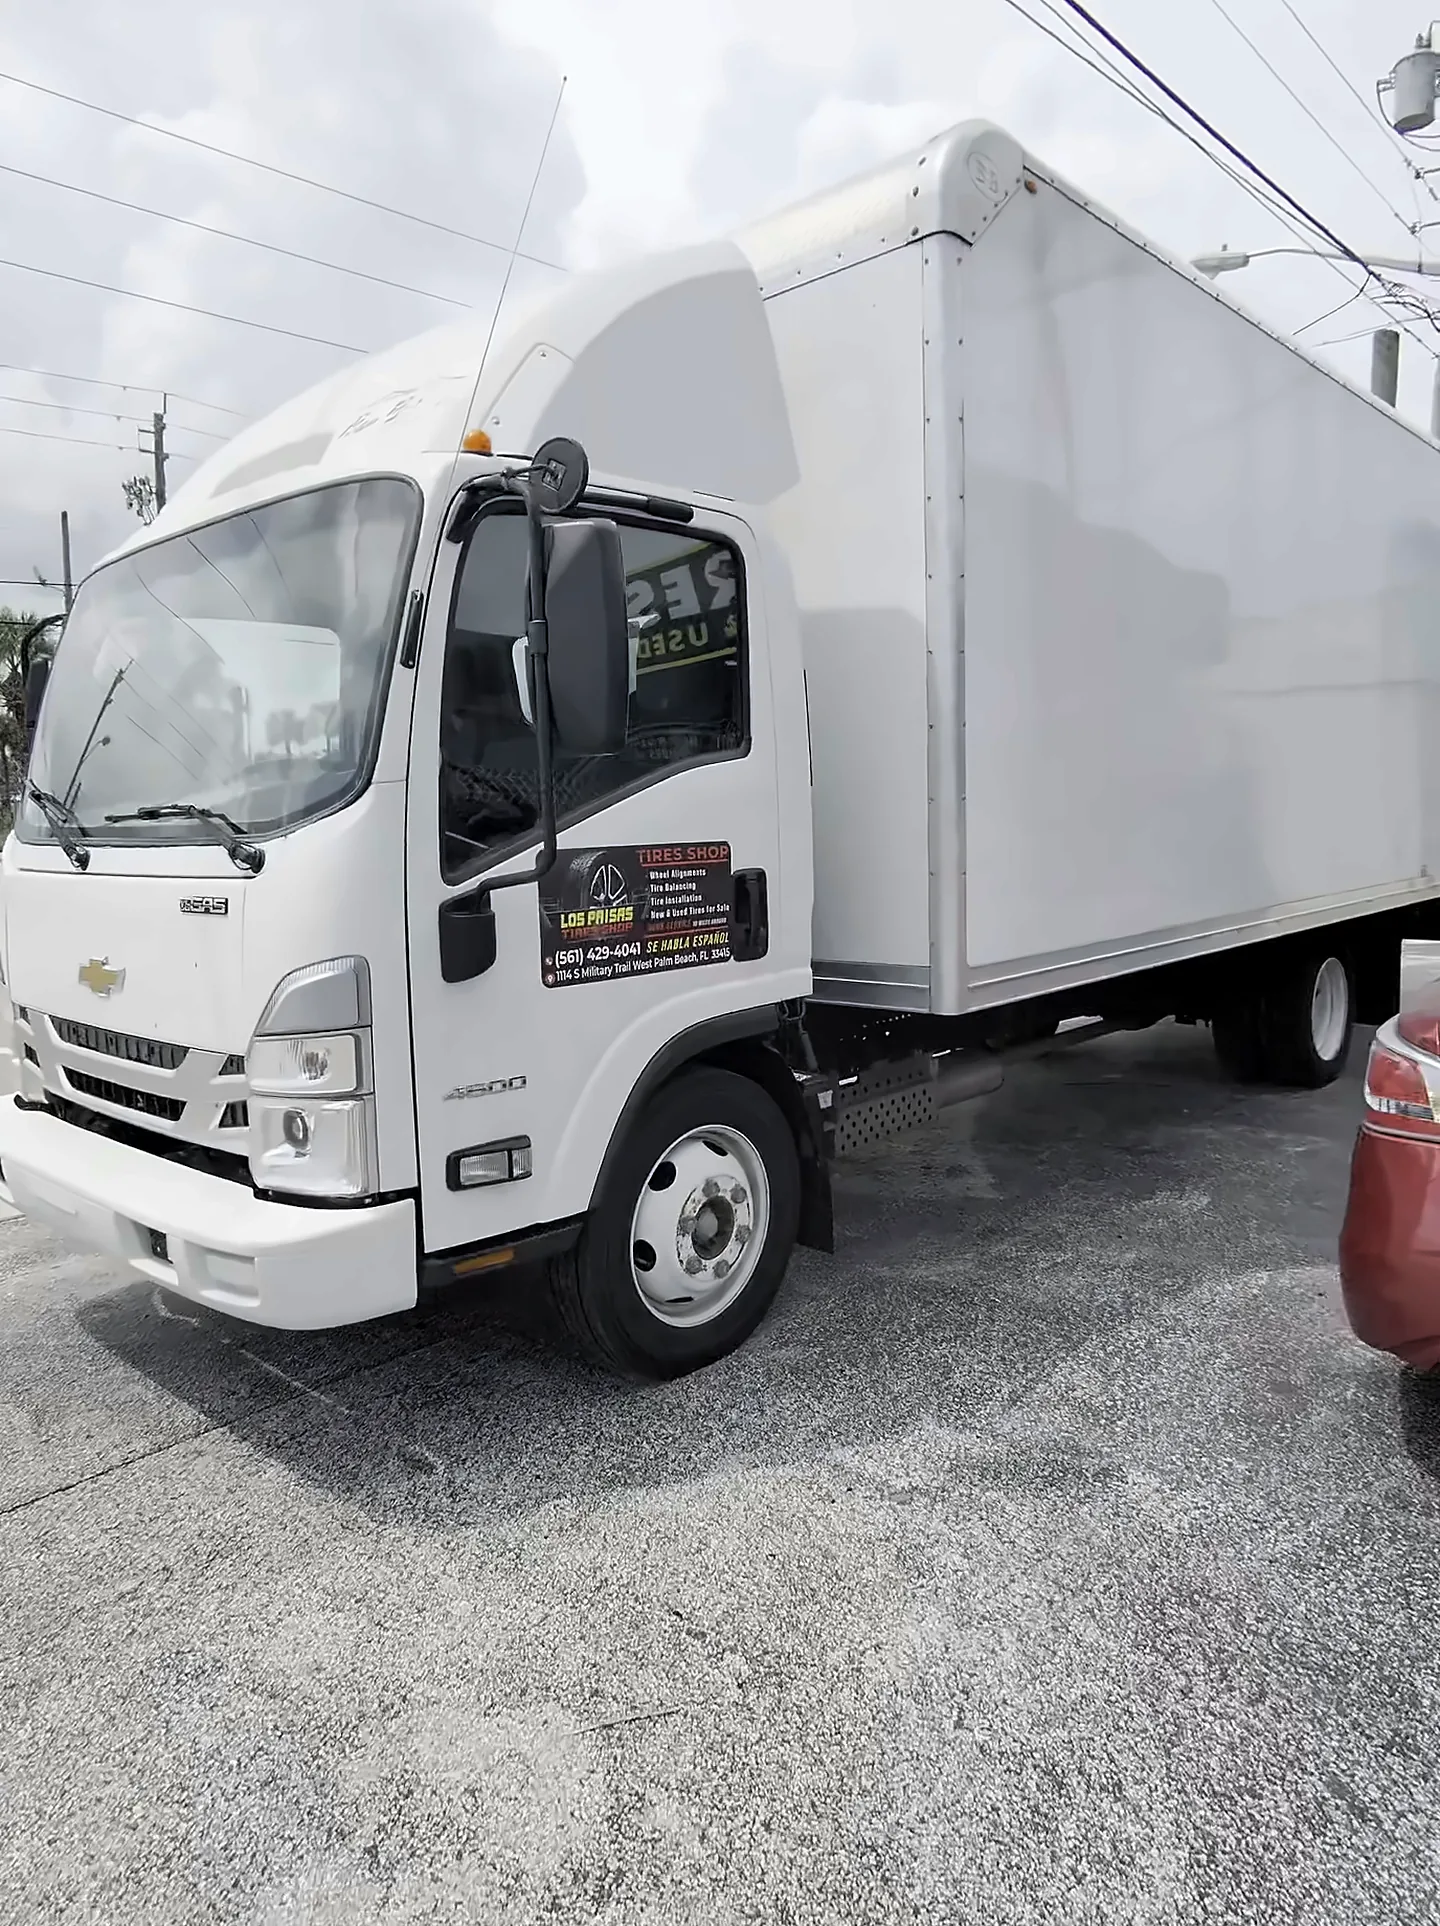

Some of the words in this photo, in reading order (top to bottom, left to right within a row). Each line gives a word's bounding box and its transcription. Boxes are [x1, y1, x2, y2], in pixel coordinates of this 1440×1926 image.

[636, 848, 682, 863] TIRES
[687, 845, 729, 860] SHOP
[649, 870, 670, 880] Wheel
[671, 868, 706, 879] Alignments
[650, 883, 663, 893] Tire
[664, 882, 696, 892] Balancing
[650, 897, 664, 906] Tire
[665, 894, 702, 905] Installation
[560, 912, 585, 929] LOS
[587, 906, 634, 925] PAISAS
[650, 910, 665, 919] New
[672, 907, 688, 917] Used
[689, 905, 705, 915] Tires
[706, 904, 715, 913] for
[716, 903, 730, 912] Sale
[602, 922, 633, 935] SHOP
[646, 941, 659, 953] SE
[661, 936, 690, 951] HABLA
[692, 931, 729, 947] ESPAÑOL
[555, 948, 584, 969] (561)
[586, 942, 641, 961] 429-4041
[556, 969, 573, 981] 1114
[573, 968, 581, 979] S
[582, 965, 613, 978] Military
[613, 961, 631, 973] Trail
[632, 959, 653, 971] West
[654, 956, 673, 968] Palm
[674, 952, 699, 965] Beach,
[699, 951, 709, 961] FL
[711, 947, 731, 959] 33415
[442, 1075, 527, 1101] 4500
